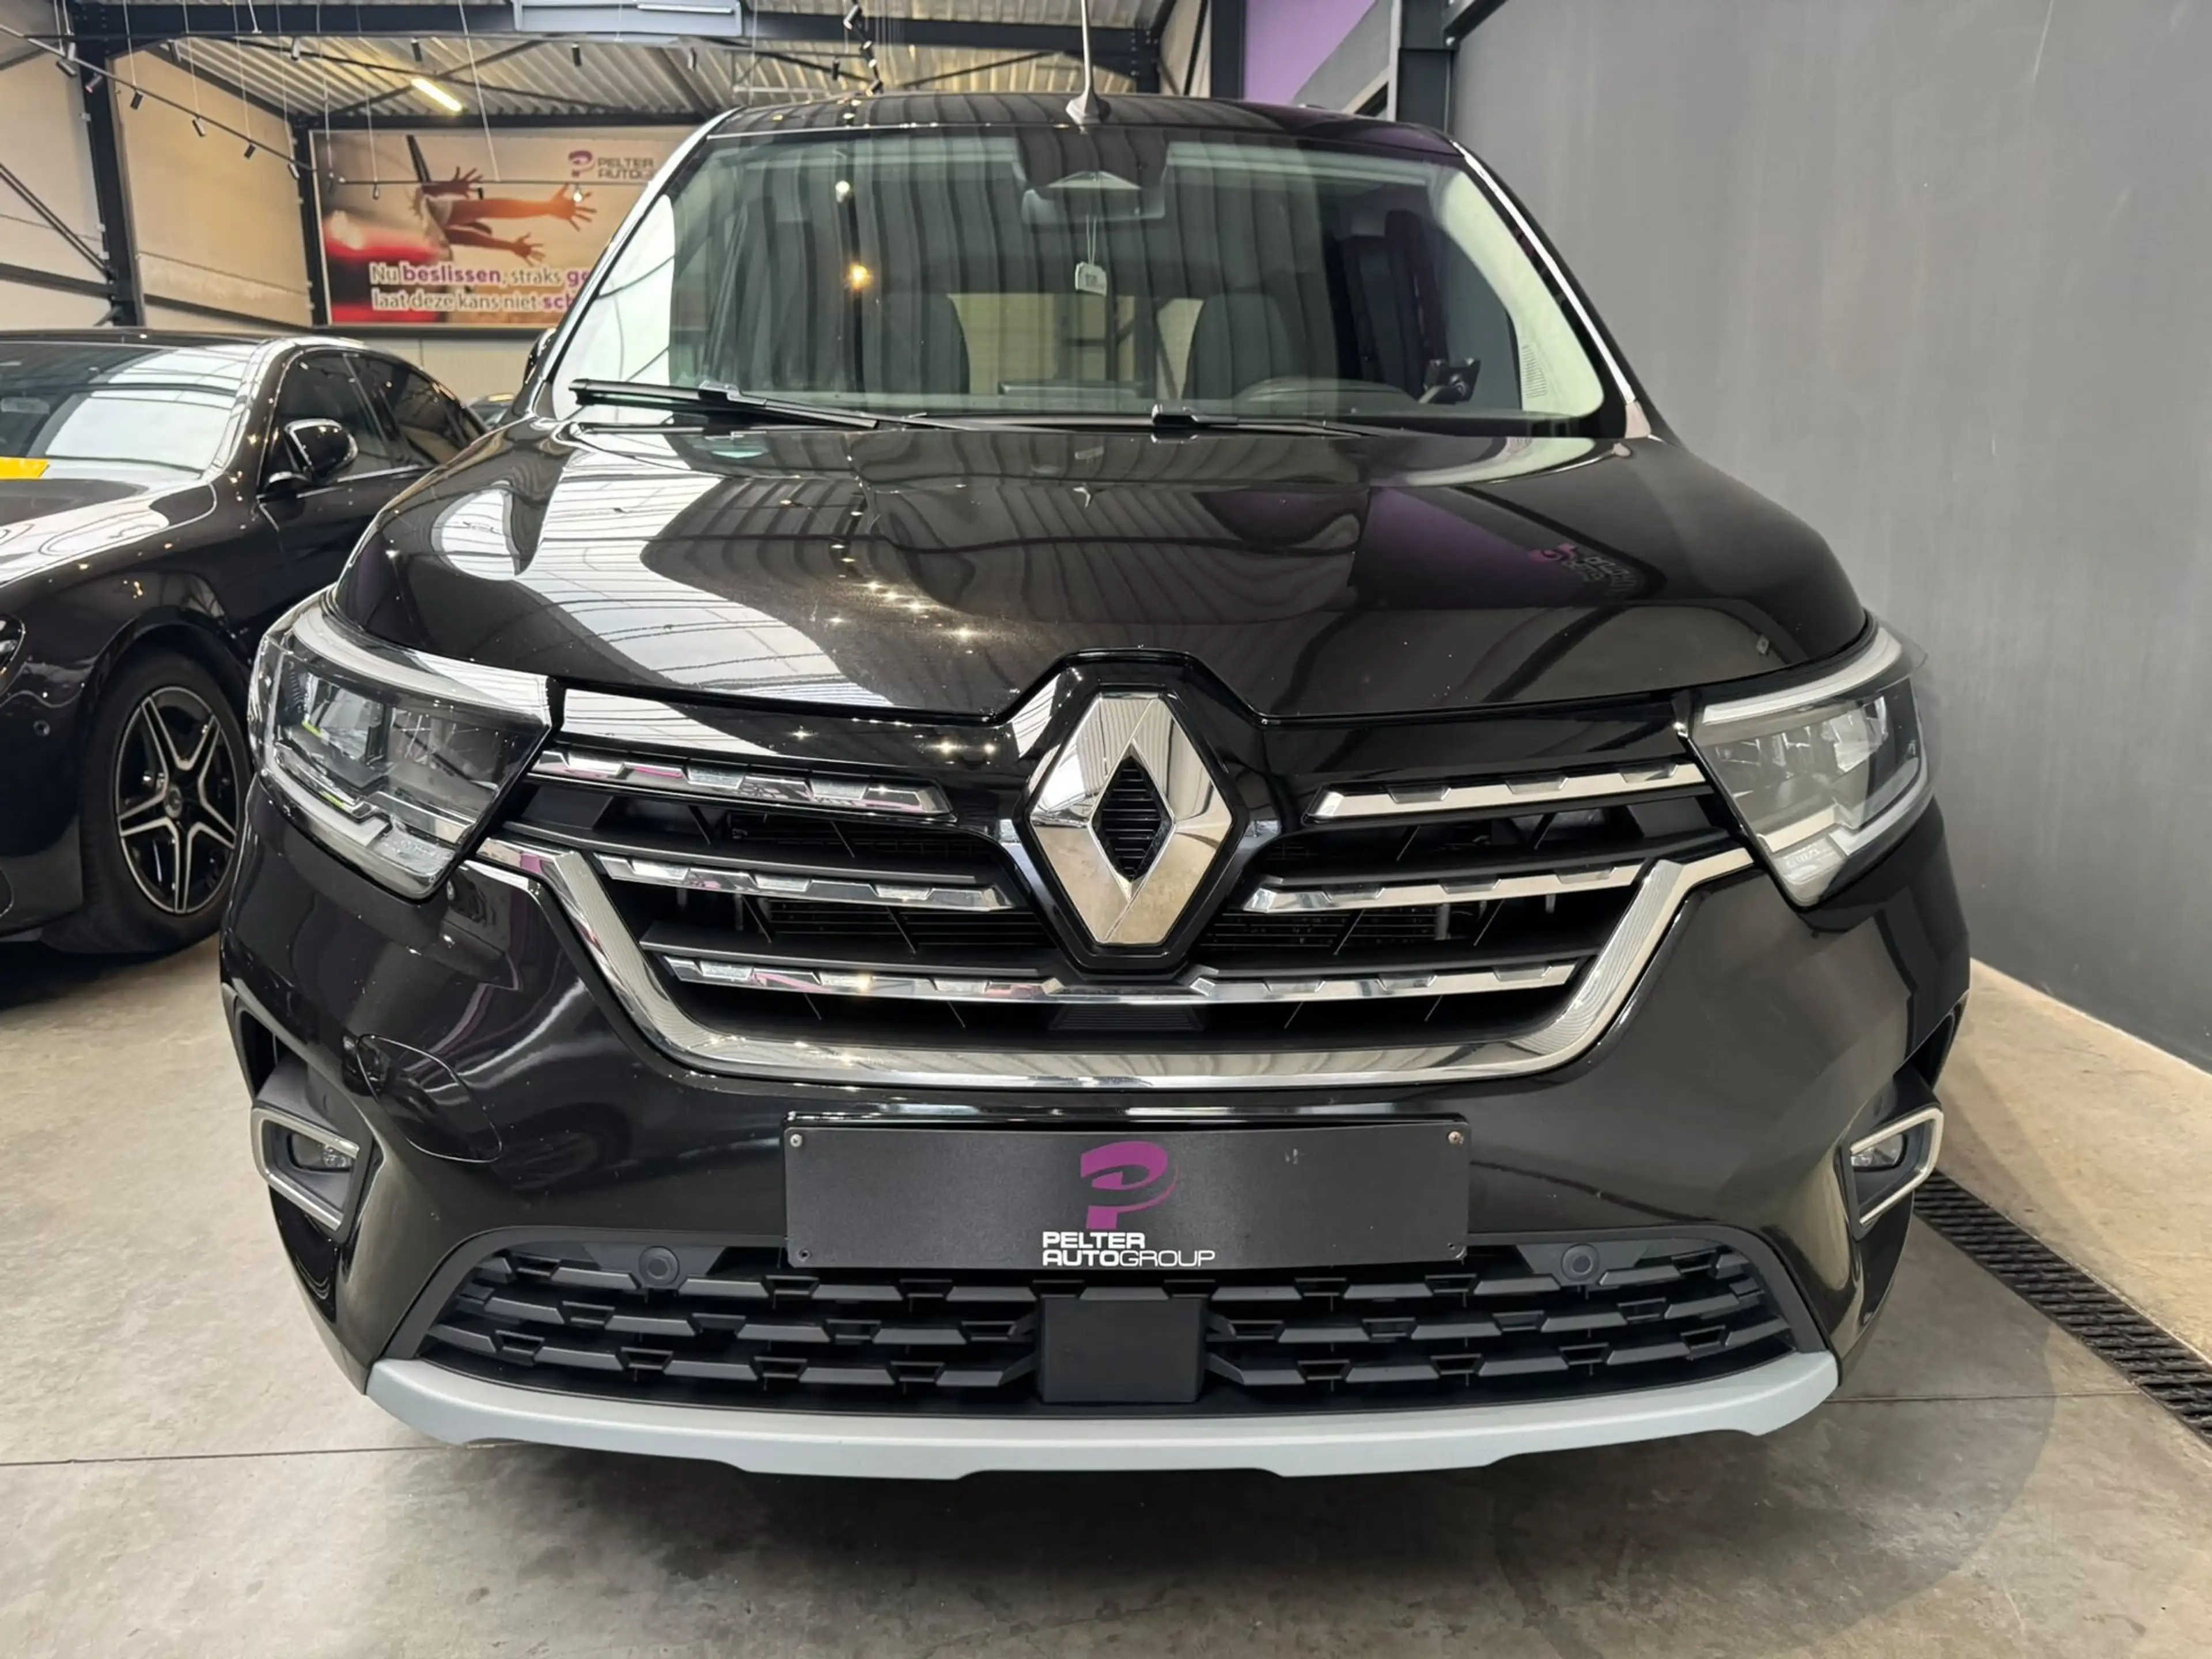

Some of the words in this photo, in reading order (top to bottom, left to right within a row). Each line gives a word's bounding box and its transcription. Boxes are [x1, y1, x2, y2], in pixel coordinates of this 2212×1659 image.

[598, 157, 653, 168] PELTER
[371, 263, 396, 281] Nu
[402, 263, 506, 284] beslissen,
[510, 267, 562, 284] straks
[375, 289, 407, 308] laat
[411, 291, 453, 309] deze
[458, 290, 499, 309] kans
[503, 293, 536, 309] niet
[1042, 1231, 1146, 1249] PELTER
[1042, 1249, 1215, 1267] AUTOGROUP
